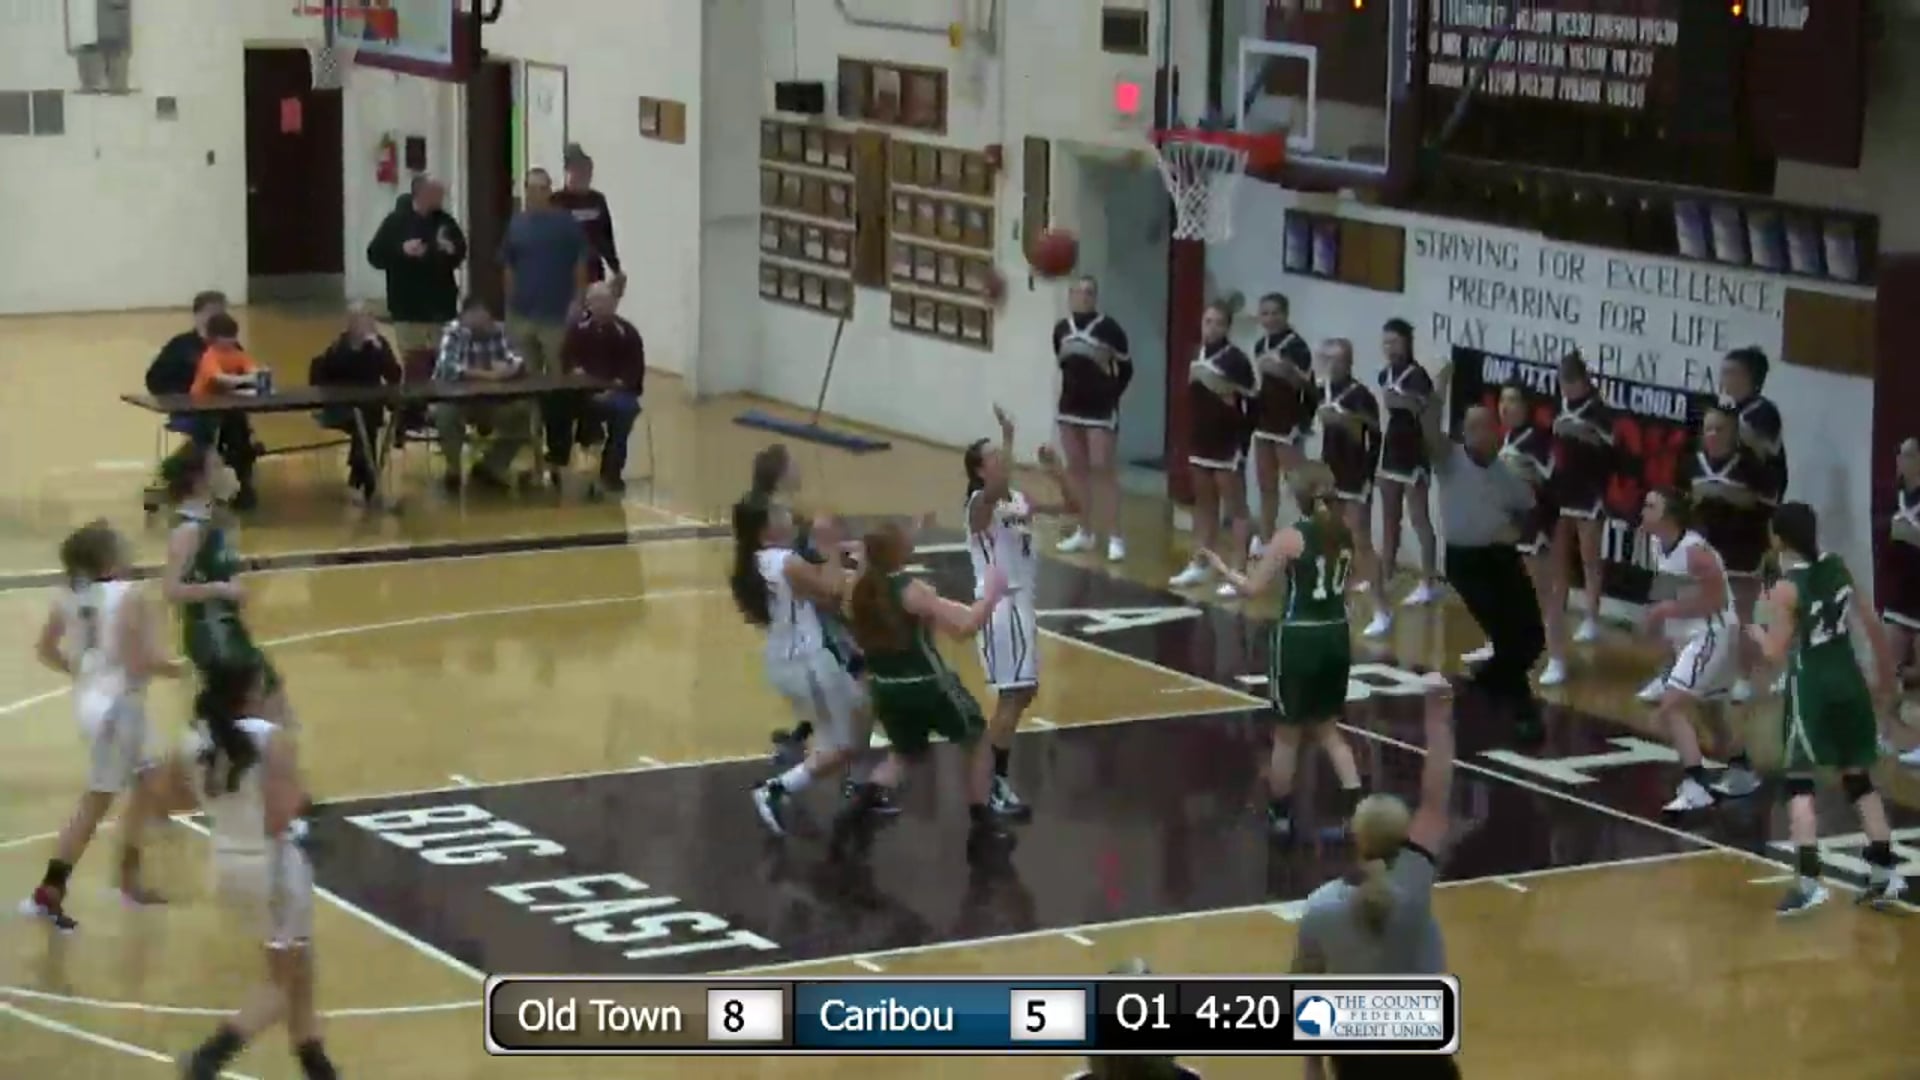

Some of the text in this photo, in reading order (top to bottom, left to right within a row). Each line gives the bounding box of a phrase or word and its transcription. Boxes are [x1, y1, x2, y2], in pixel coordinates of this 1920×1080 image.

[1414, 230, 1519, 271] STRIVING
[1537, 250, 1586, 284] FOR
[1448, 275, 1581, 325] PREPARING
[1599, 301, 1647, 336] FOR
[1432, 311, 1489, 348] PLAY
[1599, 344, 1660, 378] PLAY
[1630, 385, 1688, 420] COULD
[1312, 548, 1351, 599] 10
[343, 802, 781, 960] BIG EAST
